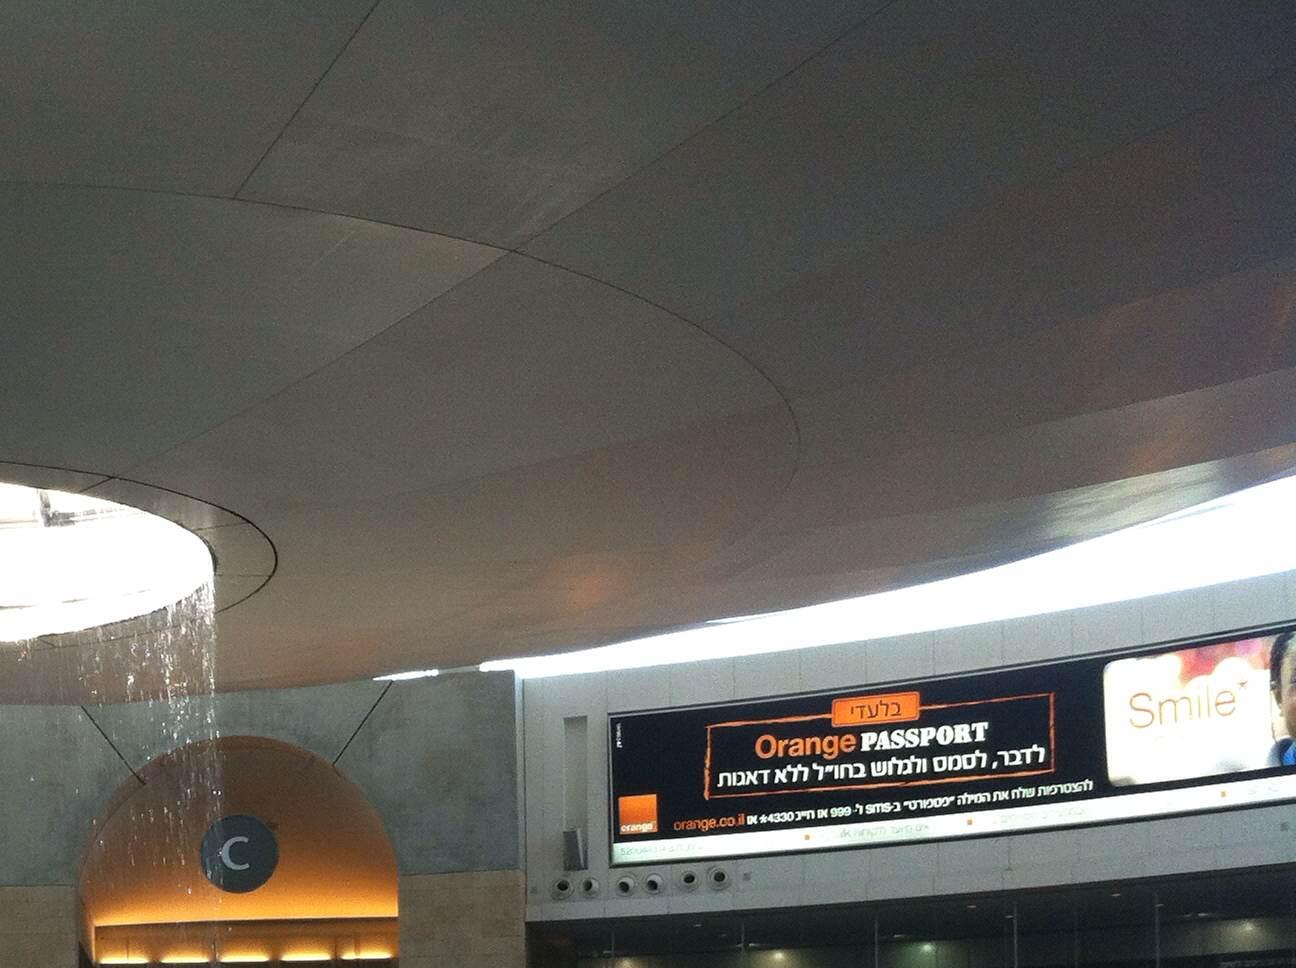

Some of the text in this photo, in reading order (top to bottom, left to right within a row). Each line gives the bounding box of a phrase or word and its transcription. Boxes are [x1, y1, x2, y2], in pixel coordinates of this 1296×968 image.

[850, 701, 902, 720] בלעדי
[755, 722, 989, 760] Orange PASSPORT
[870, 755, 927, 777] ולגלוש
[932, 749, 987, 771] לסמס
[991, 744, 1046, 770] לדבר,
[717, 767, 771, 787] דאגות
[775, 765, 809, 783] ללא
[673, 813, 745, 832] orange.co.il
[831, 807, 851, 817] 999
[221, 836, 250, 871] C
